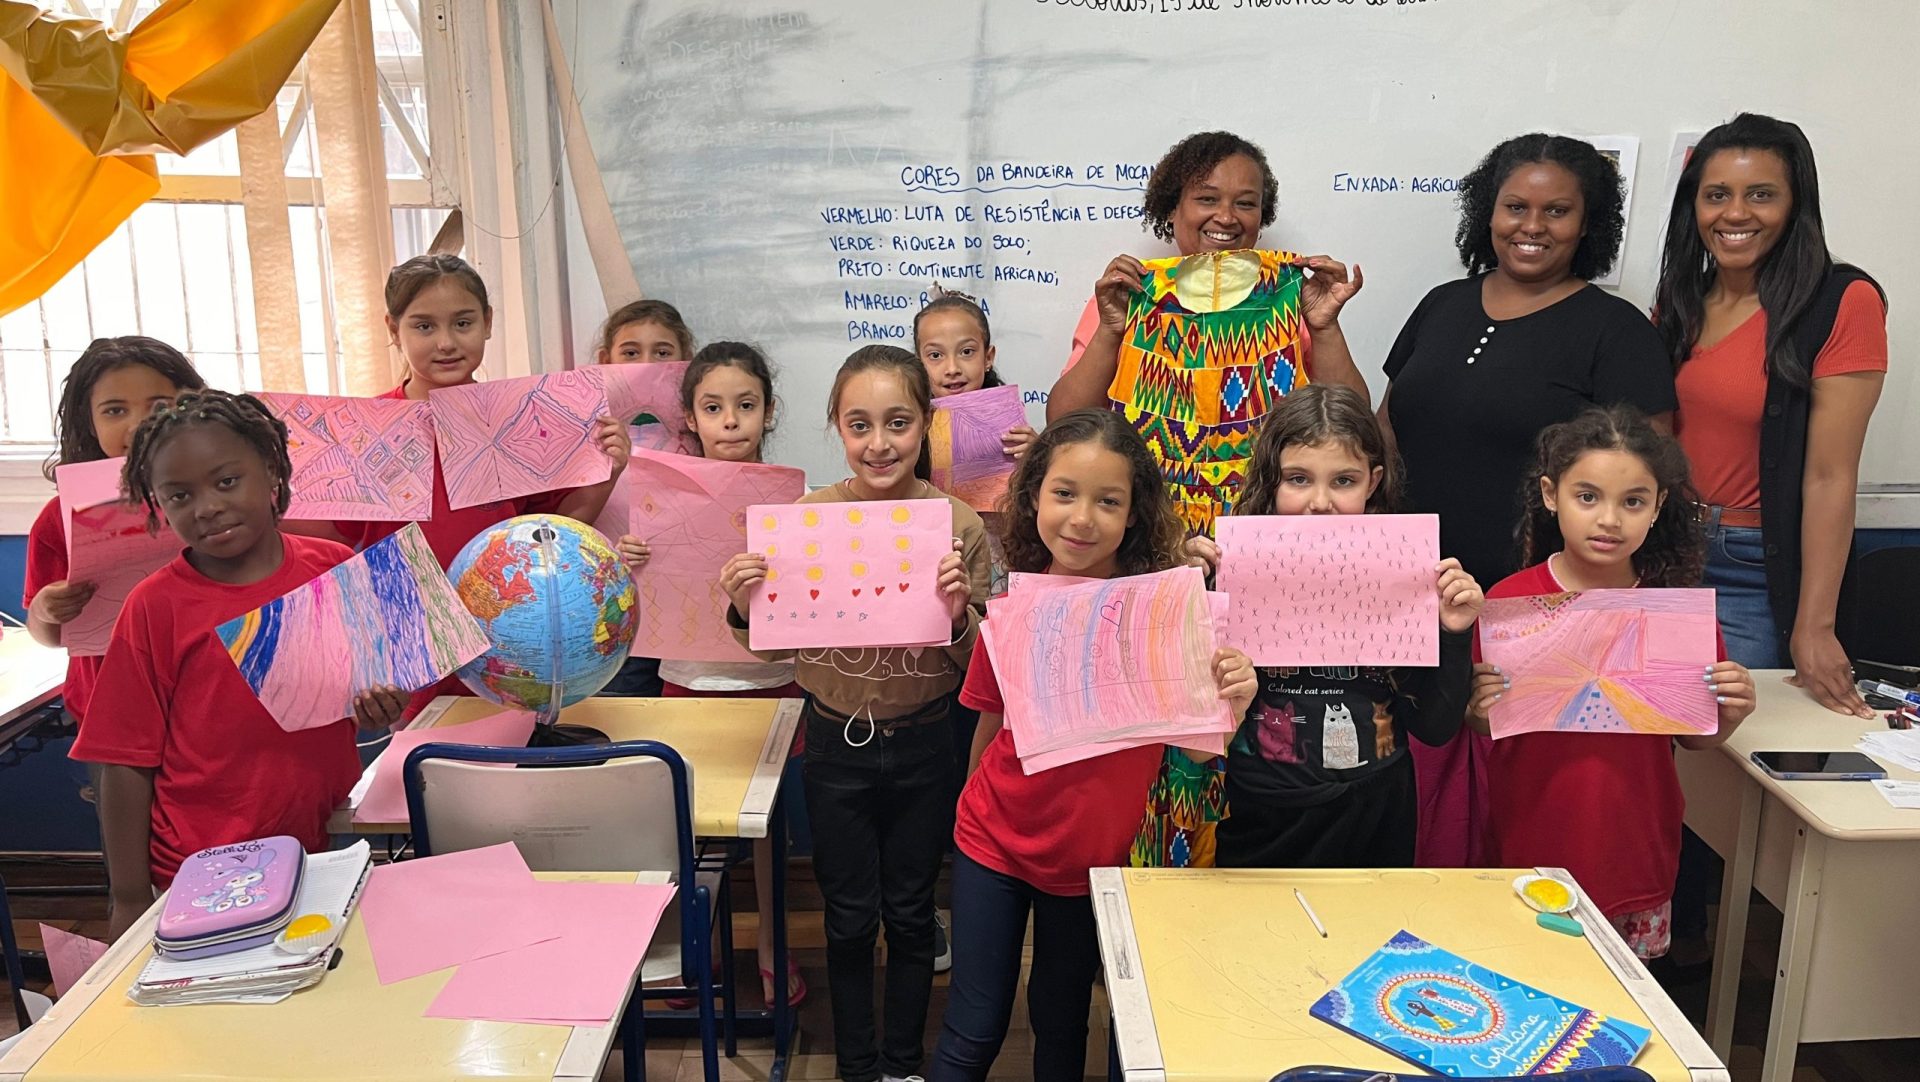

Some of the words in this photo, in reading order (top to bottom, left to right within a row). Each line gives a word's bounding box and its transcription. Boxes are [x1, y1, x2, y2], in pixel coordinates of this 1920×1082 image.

[901, 165, 961, 187] CORES
[977, 166, 995, 183] DA
[1086, 165, 1105, 180] DE
[1333, 172, 1404, 193] ENXADA:
[820, 207, 899, 225] VERMELHO:
[904, 204, 945, 222] LUTA
[955, 206, 975, 222] DE
[1088, 206, 1098, 221] E
[964, 236, 983, 249] DO
[844, 290, 913, 311] AMARELO:
[1267, 682, 1303, 695] Colored
[1304, 687, 1319, 695] cat
[1320, 687, 1345, 695] series
